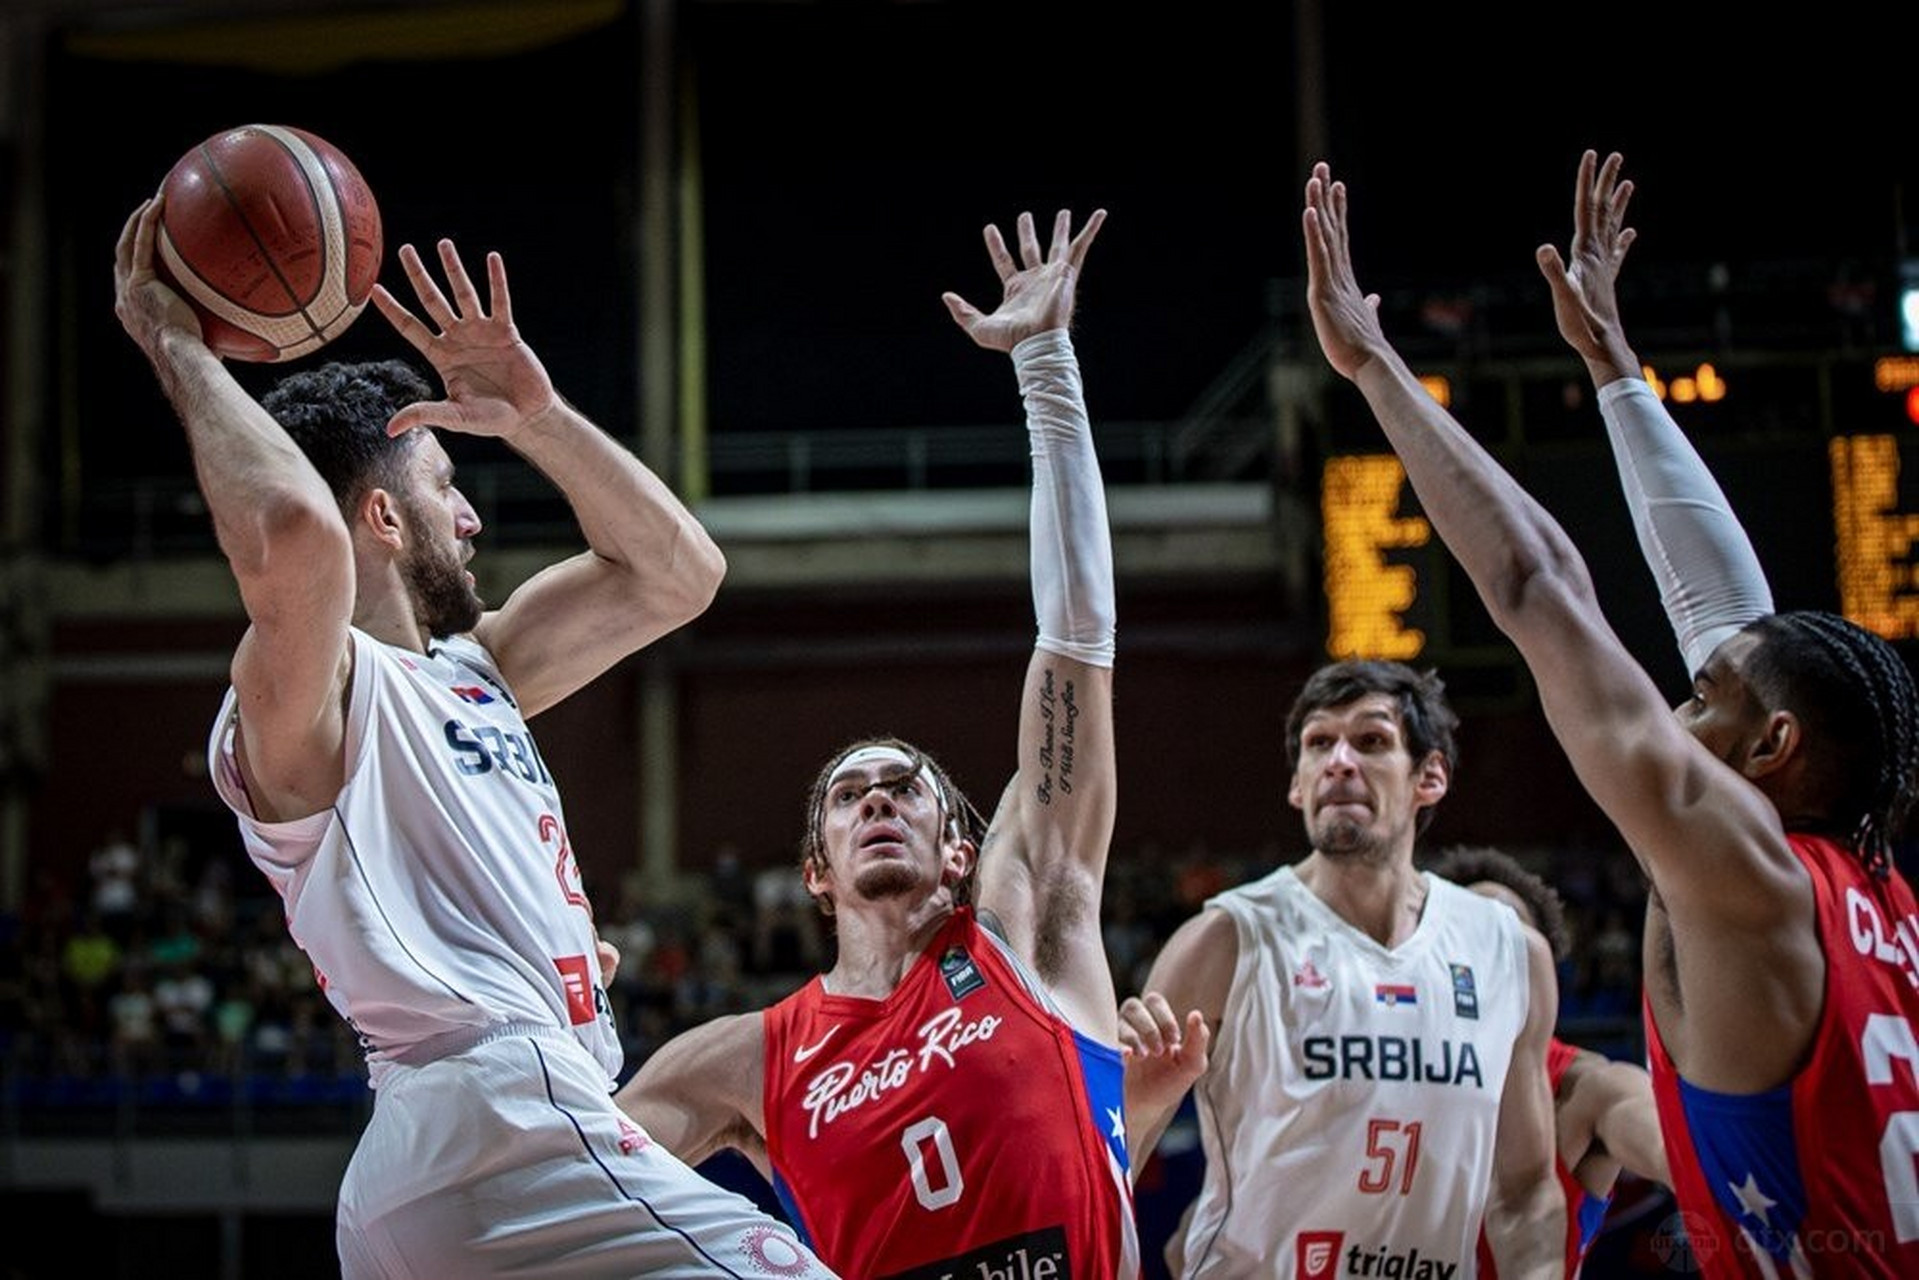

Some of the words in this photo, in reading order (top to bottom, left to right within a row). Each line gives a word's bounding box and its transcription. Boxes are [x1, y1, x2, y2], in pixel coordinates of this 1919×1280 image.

[1037, 773, 1052, 805] For
[803, 1049, 913, 1139] Puerto
[918, 1007, 1002, 1072] Rico
[1303, 1036, 1483, 1088] SRBIJA
[901, 1116, 964, 1211] 0
[1358, 1119, 1422, 1195] 51
